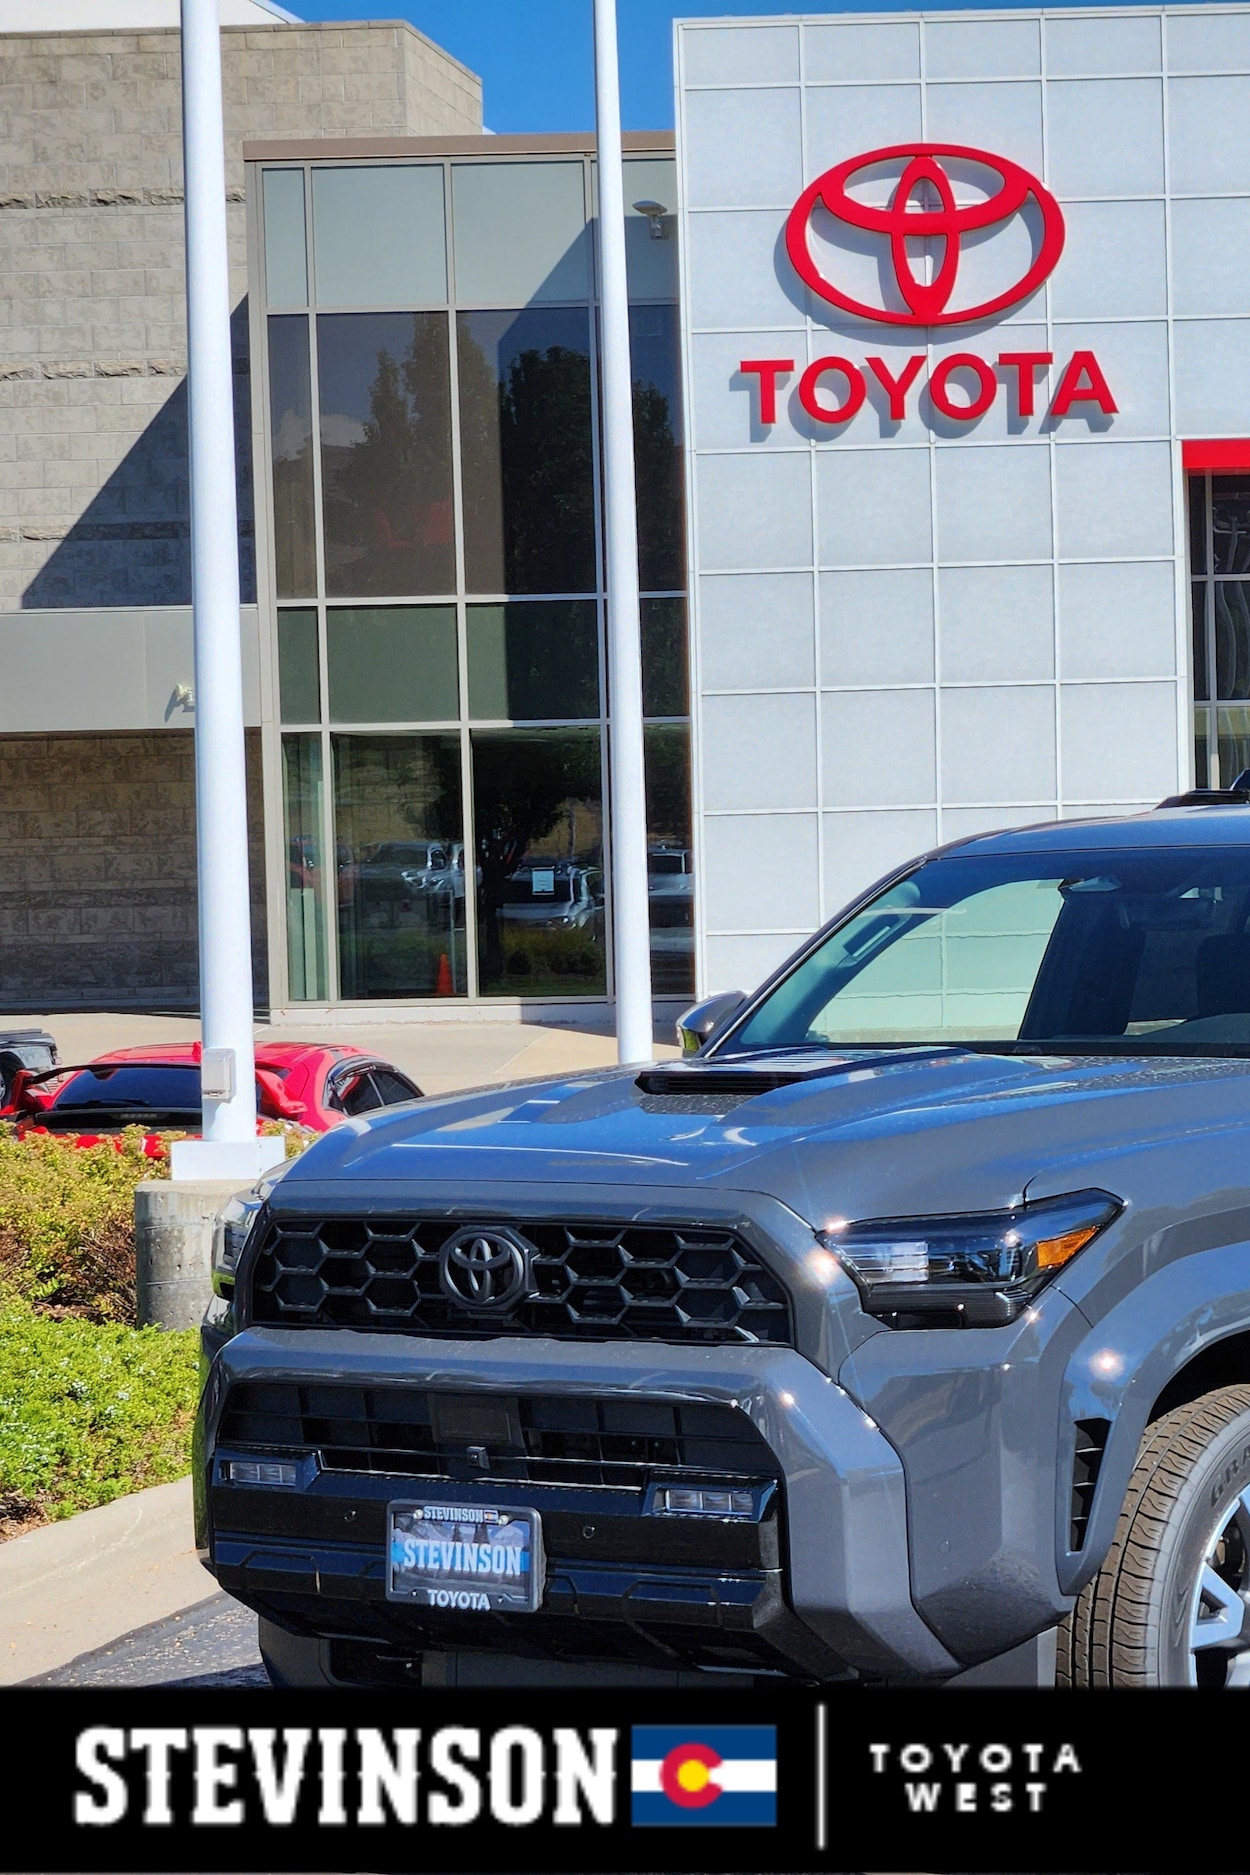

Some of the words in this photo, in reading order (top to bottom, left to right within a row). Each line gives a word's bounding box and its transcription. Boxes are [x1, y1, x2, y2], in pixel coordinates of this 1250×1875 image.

[740, 350, 1118, 424] TOYOTA
[423, 1506, 484, 1523] STEVINSON
[404, 1538, 522, 1576] STEVINSON
[427, 1588, 491, 1611] TOYOTA
